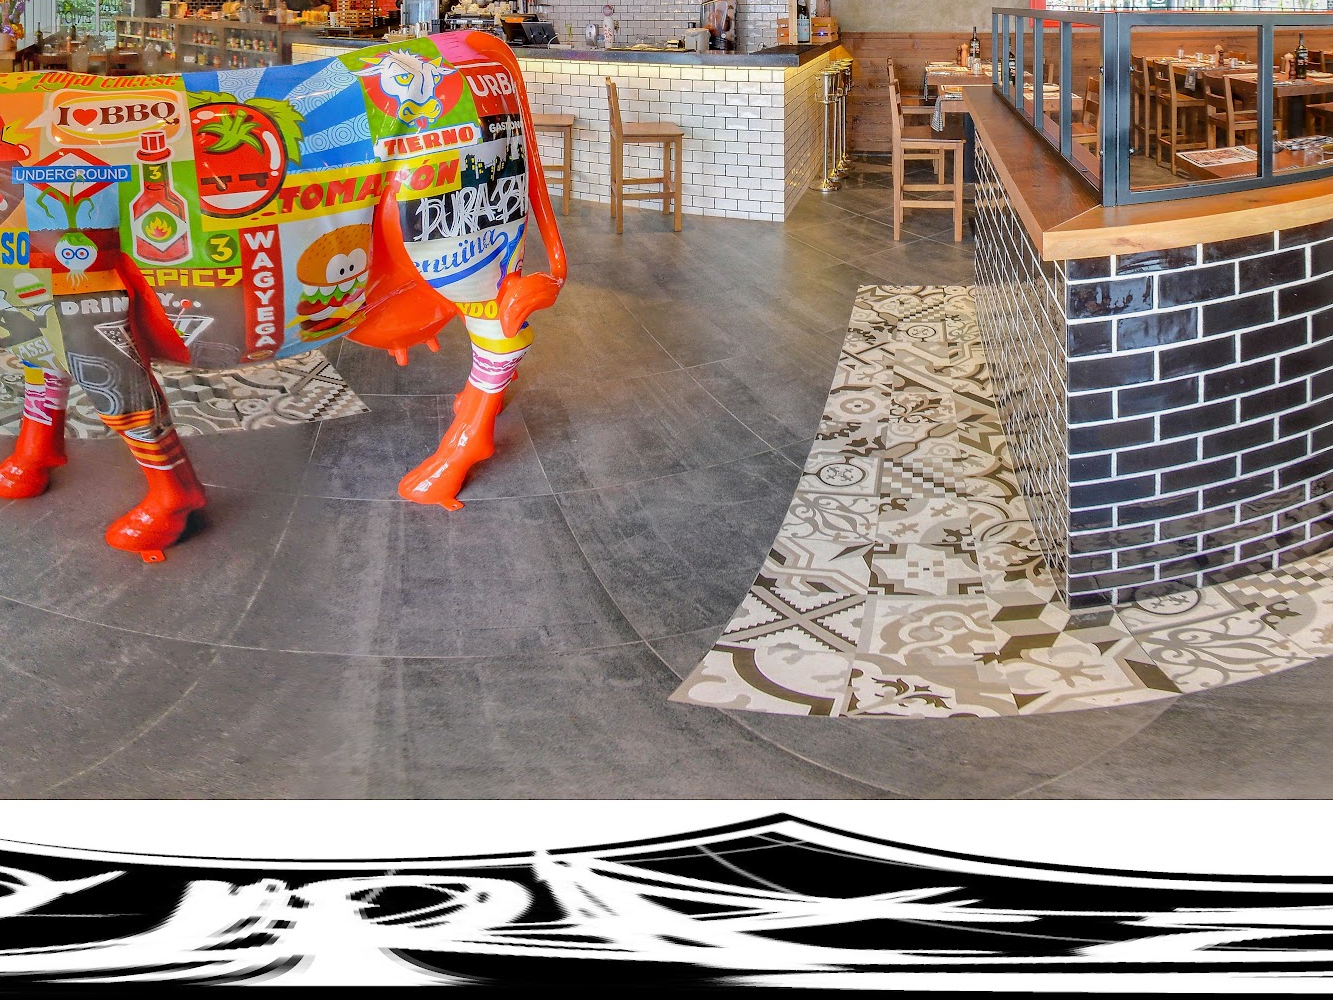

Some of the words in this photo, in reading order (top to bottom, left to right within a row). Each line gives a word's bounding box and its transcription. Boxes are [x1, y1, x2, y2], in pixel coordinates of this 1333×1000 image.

[100, 74, 179, 89] cheese
[100, 102, 180, 125] BBQ
[383, 125, 475, 157] TIERNO
[15, 167, 129, 181] UNDERGROUND
[147, 166, 162, 180] 3
[209, 236, 234, 262] 3
[243, 229, 277, 349] WAGYEGA
